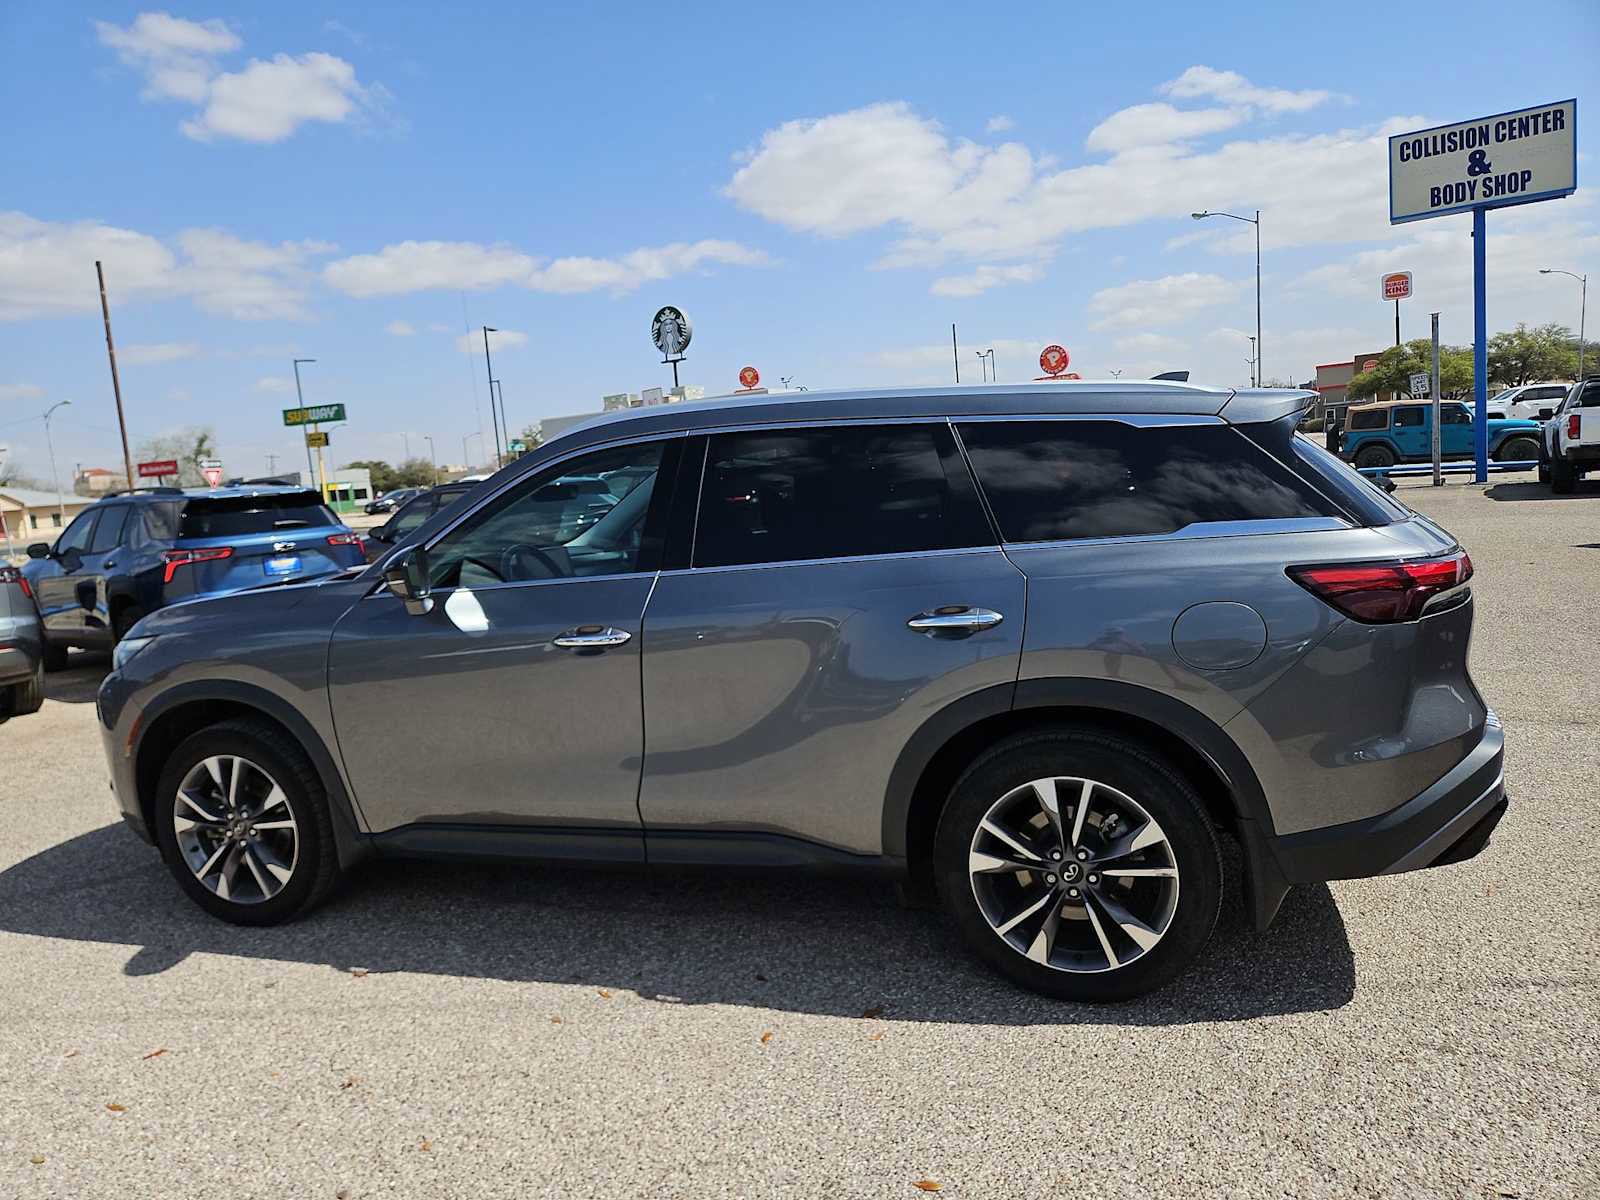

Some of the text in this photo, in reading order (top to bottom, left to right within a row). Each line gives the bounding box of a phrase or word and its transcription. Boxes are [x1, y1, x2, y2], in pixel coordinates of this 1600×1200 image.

[1399, 109, 1565, 162] COLLISION CENTER
[1467, 149, 1492, 177] &
[1430, 170, 1532, 207] BODY SHOP
[1385, 286, 1409, 294] KING
[1413, 384, 1428, 392] 35
